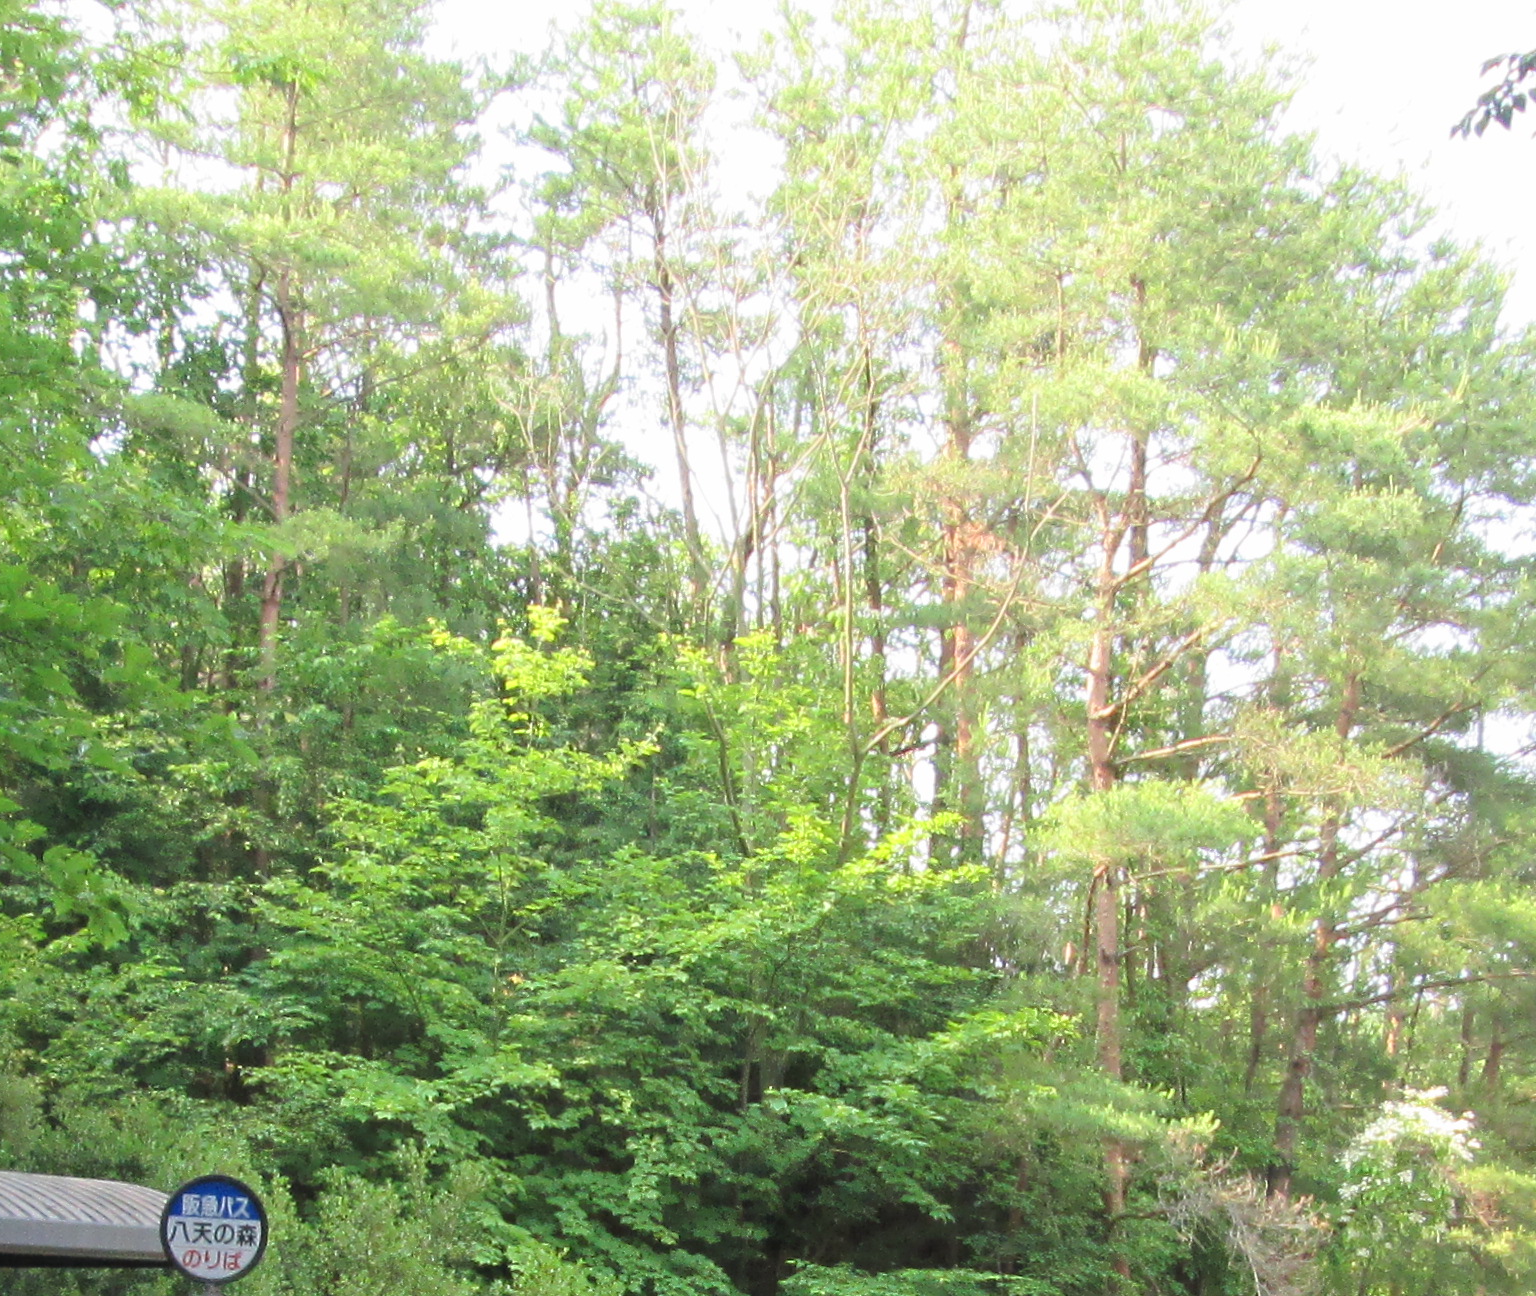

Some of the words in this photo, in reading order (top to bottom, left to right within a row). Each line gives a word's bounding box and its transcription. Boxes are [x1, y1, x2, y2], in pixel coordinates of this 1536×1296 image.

[182, 1193, 251, 1219] 阪急バス
[169, 1221, 258, 1247] 八天の森
[182, 1250, 242, 1271] のりば
